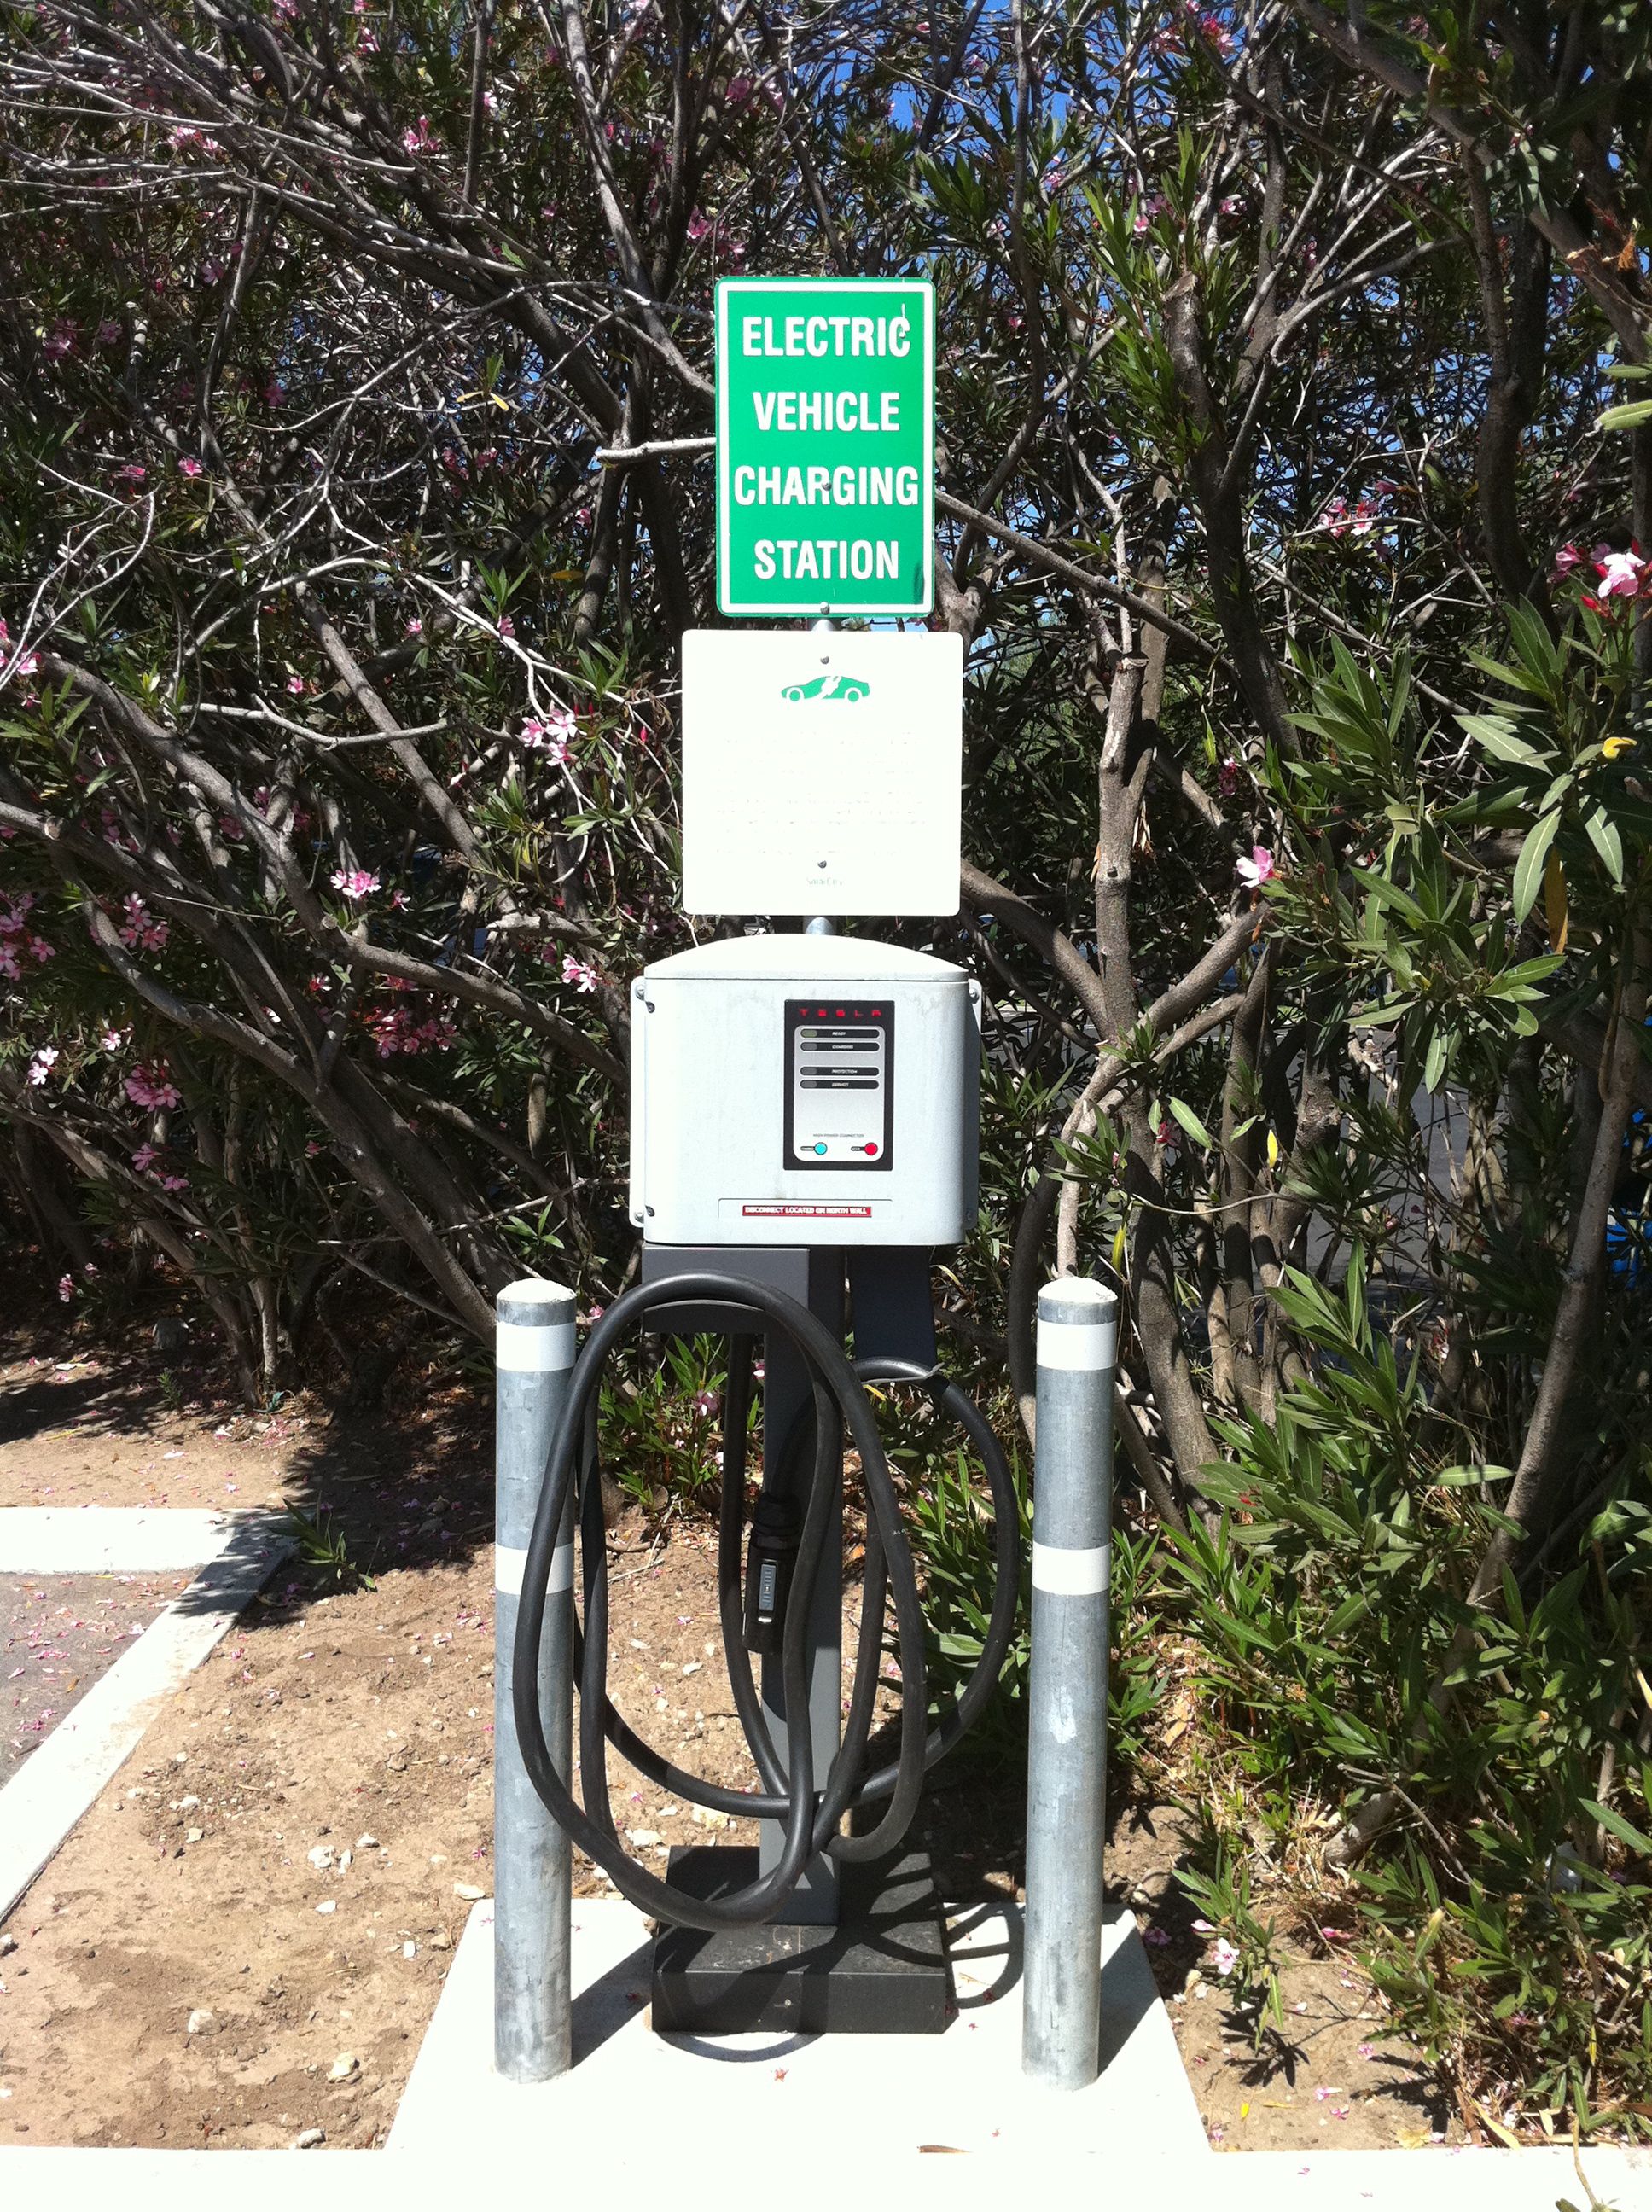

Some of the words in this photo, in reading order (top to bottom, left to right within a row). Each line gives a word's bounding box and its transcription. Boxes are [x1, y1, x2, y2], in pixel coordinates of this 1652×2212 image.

[742, 316, 911, 358] ELECTRIC
[752, 391, 901, 432] VEHICLE
[733, 465, 920, 507] CHARGING
[753, 539, 900, 581] STATION
[799, 1009, 881, 1017] TESLA
